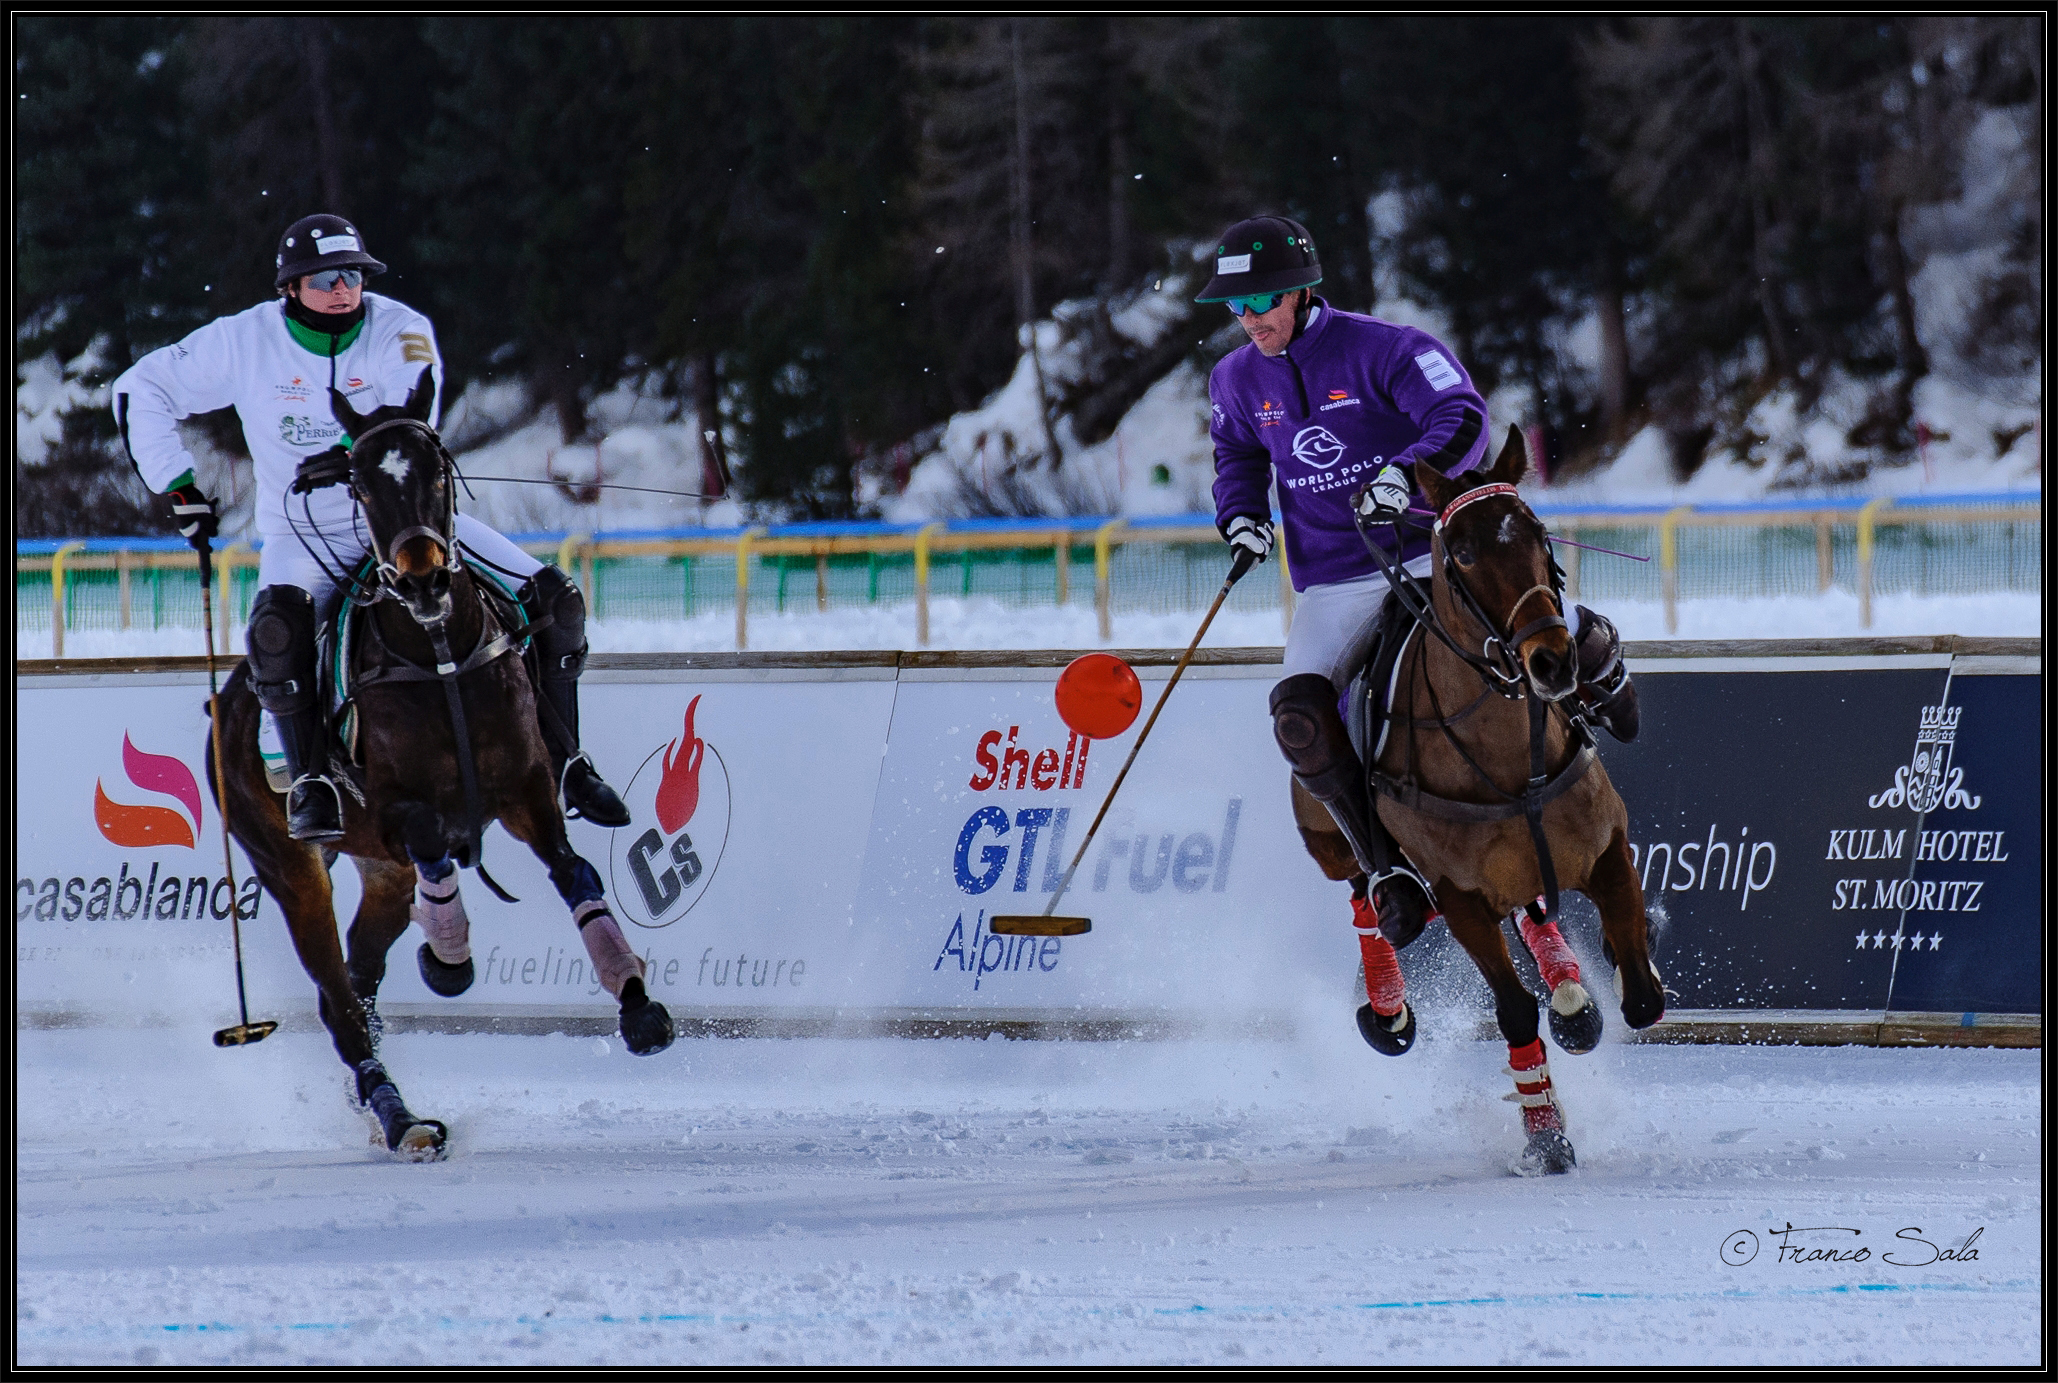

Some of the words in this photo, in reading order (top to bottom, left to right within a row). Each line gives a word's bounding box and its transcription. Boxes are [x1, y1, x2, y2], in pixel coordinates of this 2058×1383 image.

[398, 332, 435, 364] 2
[1414, 349, 1462, 391] 3
[1320, 397, 1360, 411] casablanca
[297, 424, 343, 441] PERRIE
[1286, 472, 1334, 489] WORLD
[1340, 455, 1383, 477] POLO
[1313, 476, 1357, 493] LEAGUE
[969, 726, 1090, 791] Shell
[954, 806, 1071, 895] GTL
[1092, 799, 1243, 893] Fuel
[1825, 830, 1907, 861] KULM
[1916, 830, 2009, 862] HOTEL
[17, 862, 262, 921] casablanca
[626, 828, 702, 920] Cs
[1871, 879, 1984, 912] MORITZ
[645, 948, 679, 986] he
[697, 948, 806, 987] future
[934, 909, 1062, 990] Alpine
